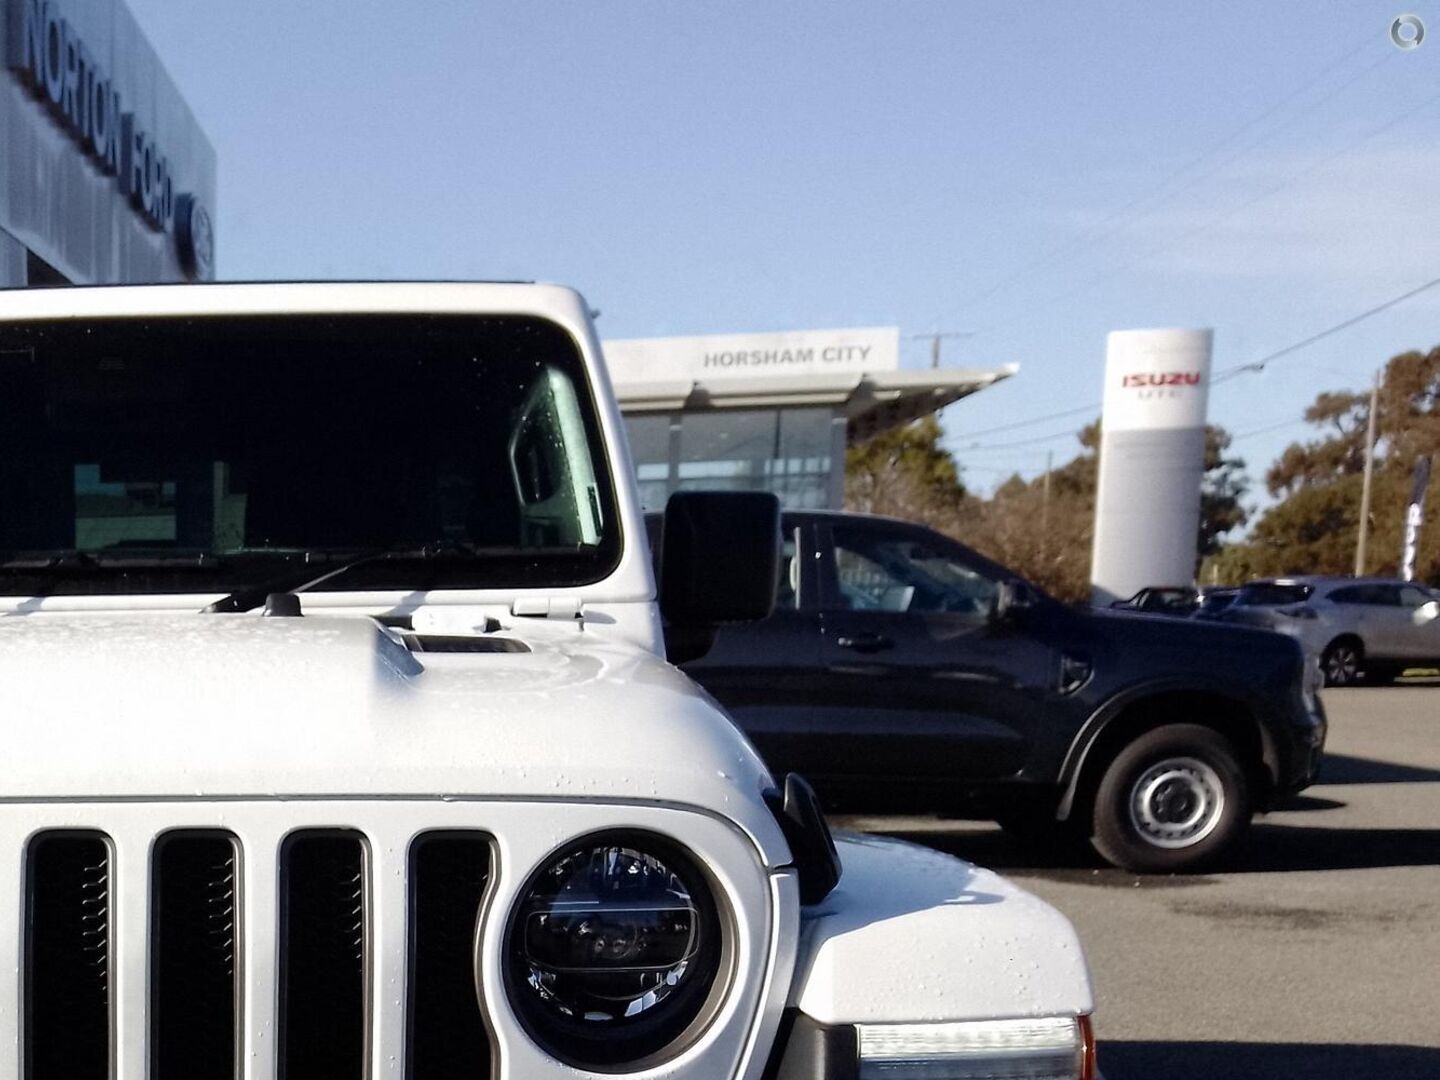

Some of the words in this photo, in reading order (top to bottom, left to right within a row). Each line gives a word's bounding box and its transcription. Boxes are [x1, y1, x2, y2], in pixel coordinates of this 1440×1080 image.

[120, 113, 174, 232] FORD
[704, 349, 814, 368] HORSHAM
[822, 345, 871, 362] CITY
[1122, 371, 1200, 388] ISUZU
